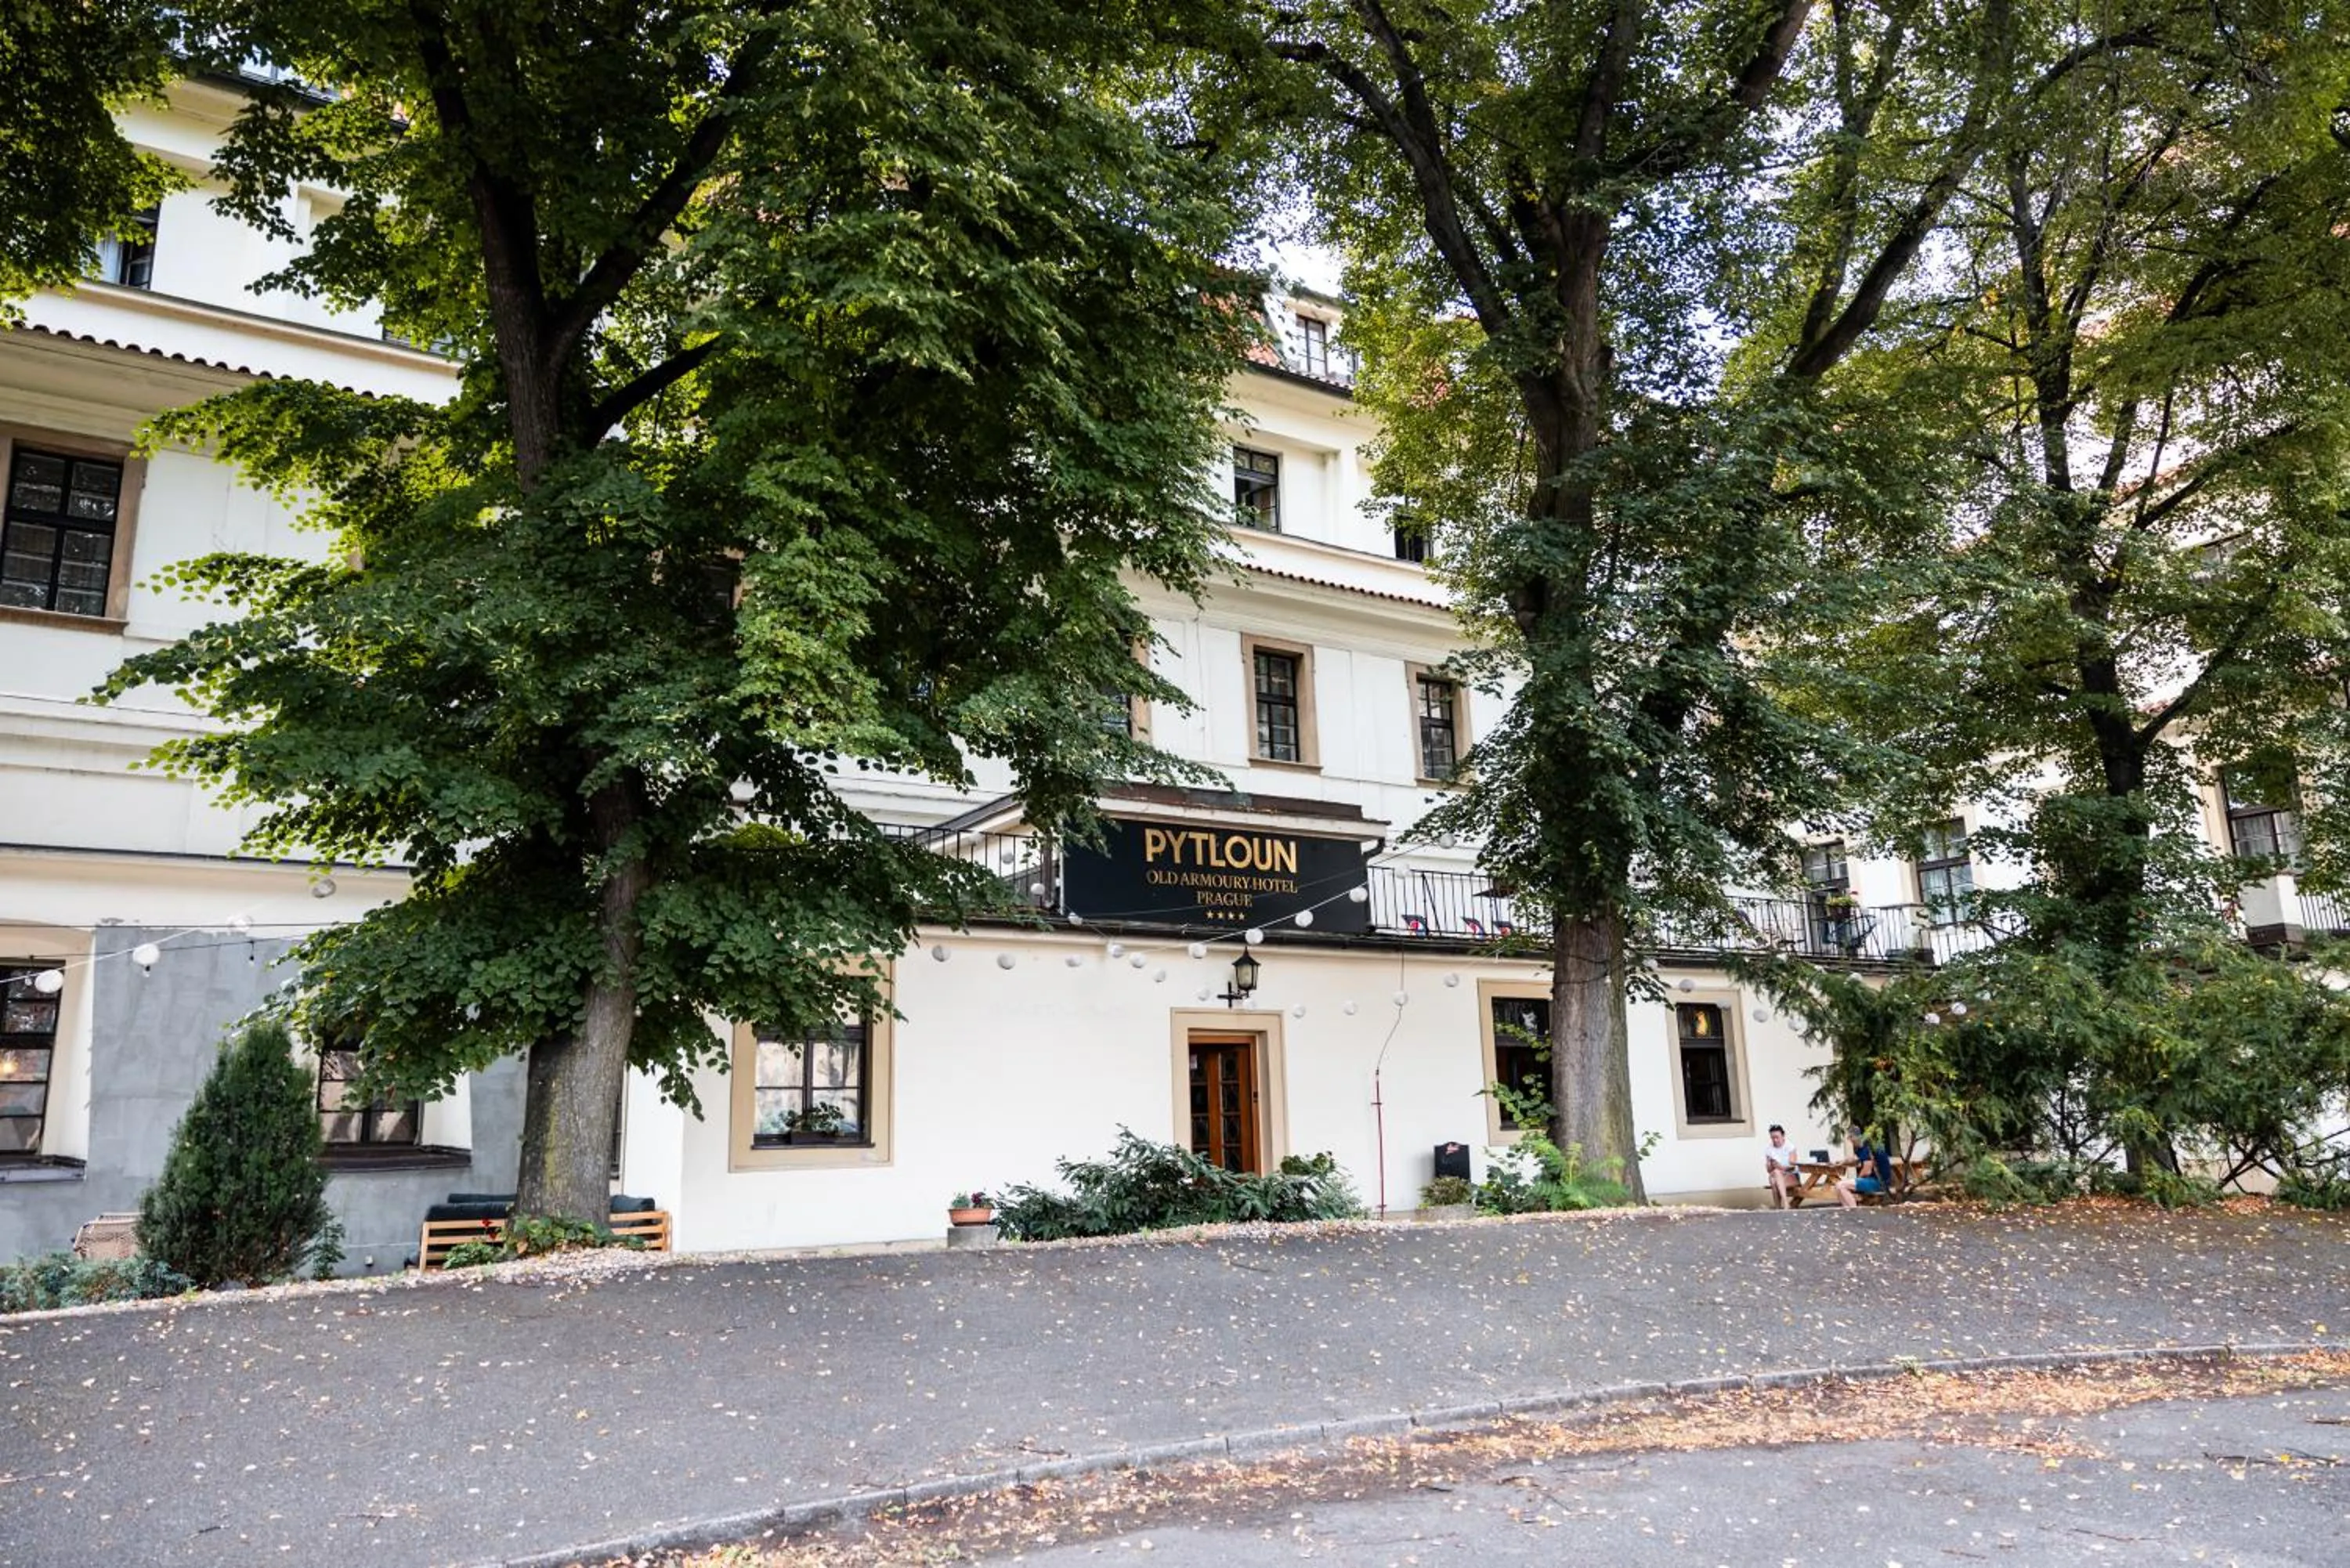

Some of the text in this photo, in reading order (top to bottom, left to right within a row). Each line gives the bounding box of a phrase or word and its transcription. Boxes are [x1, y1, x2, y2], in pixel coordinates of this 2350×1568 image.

[1144, 828, 1297, 873] PYTLOUN
[1146, 869, 1298, 894] OLD ARMOURY HOTEL
[1197, 891, 1253, 907] PRAGUE
